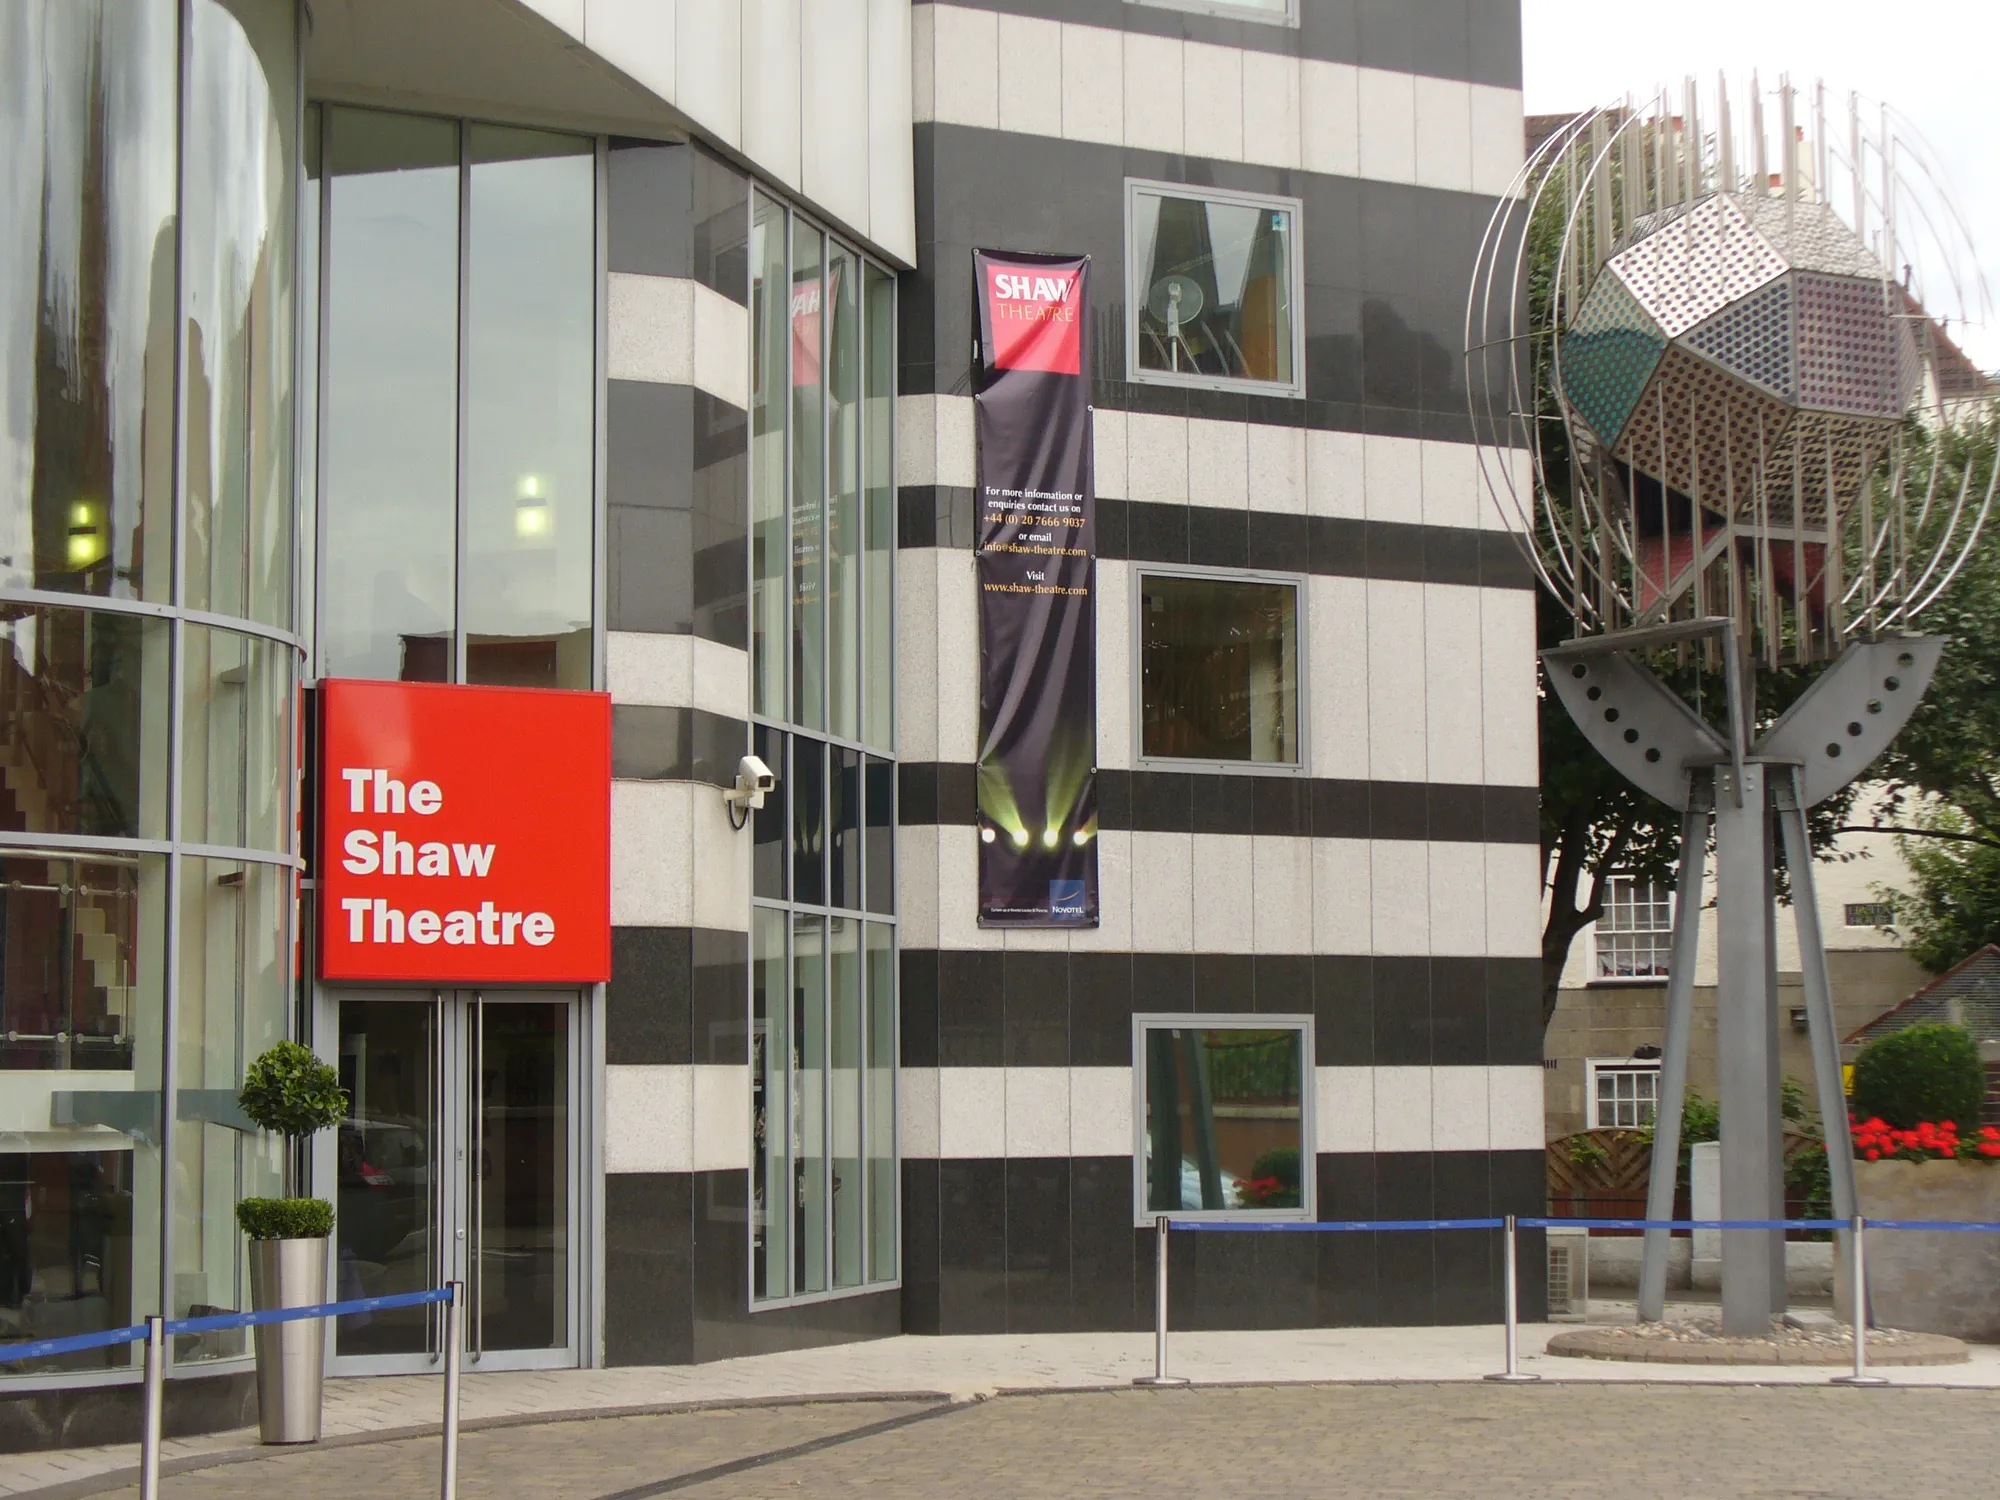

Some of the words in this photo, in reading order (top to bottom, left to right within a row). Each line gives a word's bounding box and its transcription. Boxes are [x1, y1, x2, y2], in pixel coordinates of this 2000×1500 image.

[995, 273, 1074, 303] SHAW
[997, 303, 1074, 322] THEATRE
[985, 486, 1000, 496] For
[1001, 488, 1023, 498] more
[1024, 488, 1073, 500] information
[1074, 493, 1083, 501] or
[988, 500, 1026, 511] enquiries
[1027, 503, 1057, 513] contact
[1059, 505, 1070, 513] us
[1071, 505, 1081, 513] on
[983, 513, 1003, 523] +44
[1005, 514, 1018, 526] (0)
[1021, 515, 1034, 526] 20
[1035, 516, 1060, 527] 7666
[1062, 517, 1086, 528] 9037
[1018, 533, 1027, 541] or
[1028, 532, 1052, 542] email
[984, 541, 1087, 557] info@shaw-theatre.com
[1026, 571, 1045, 581] Visit
[984, 582, 1088, 596] www.shaw-theatre.com
[341, 767, 443, 816] The
[341, 828, 496, 878] Shaw
[1052, 905, 1085, 914] NOVOTEL
[341, 897, 556, 947] Theatre
